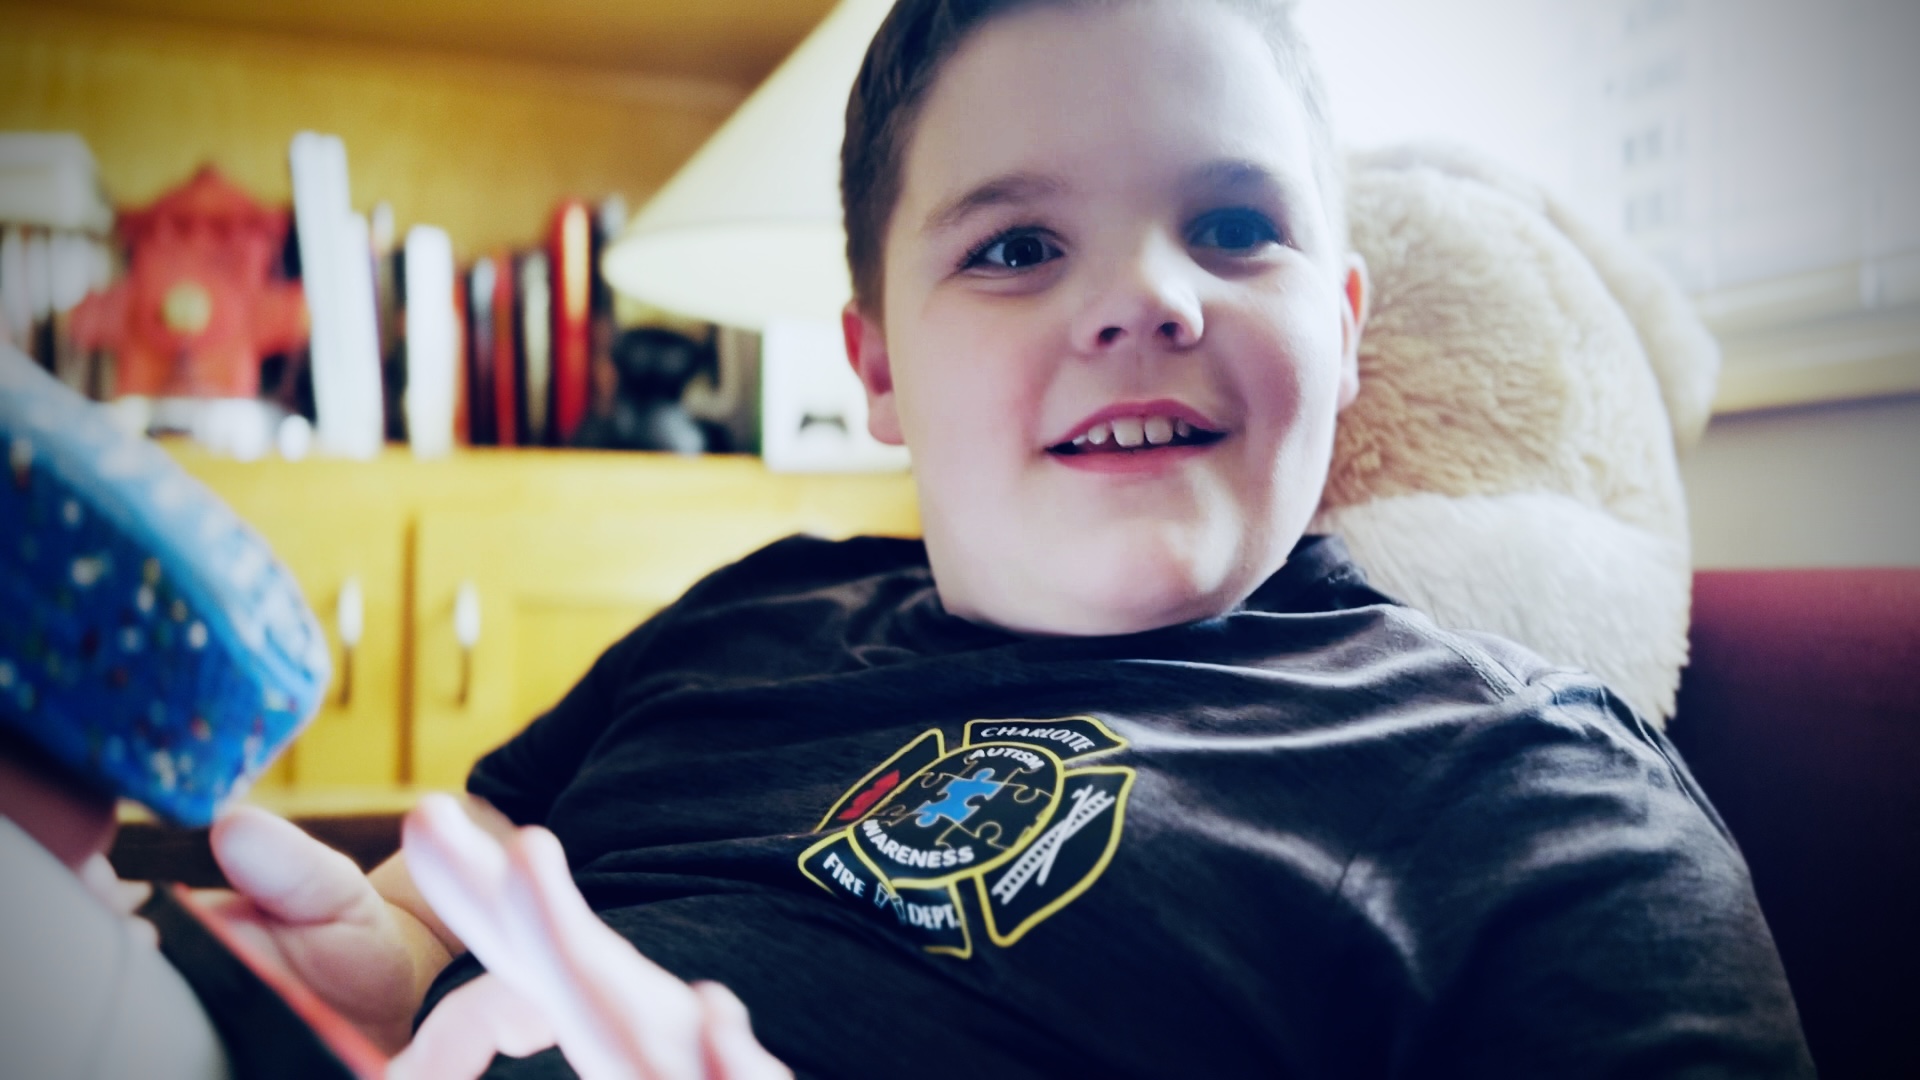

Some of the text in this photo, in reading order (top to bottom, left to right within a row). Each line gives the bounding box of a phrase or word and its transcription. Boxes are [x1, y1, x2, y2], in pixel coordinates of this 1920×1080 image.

[980, 726, 1095, 753] CHARLOTTE
[970, 748, 1045, 770] AUTISM
[862, 819, 975, 868] WARENESS
[822, 851, 961, 929] FIRE DEPT.
